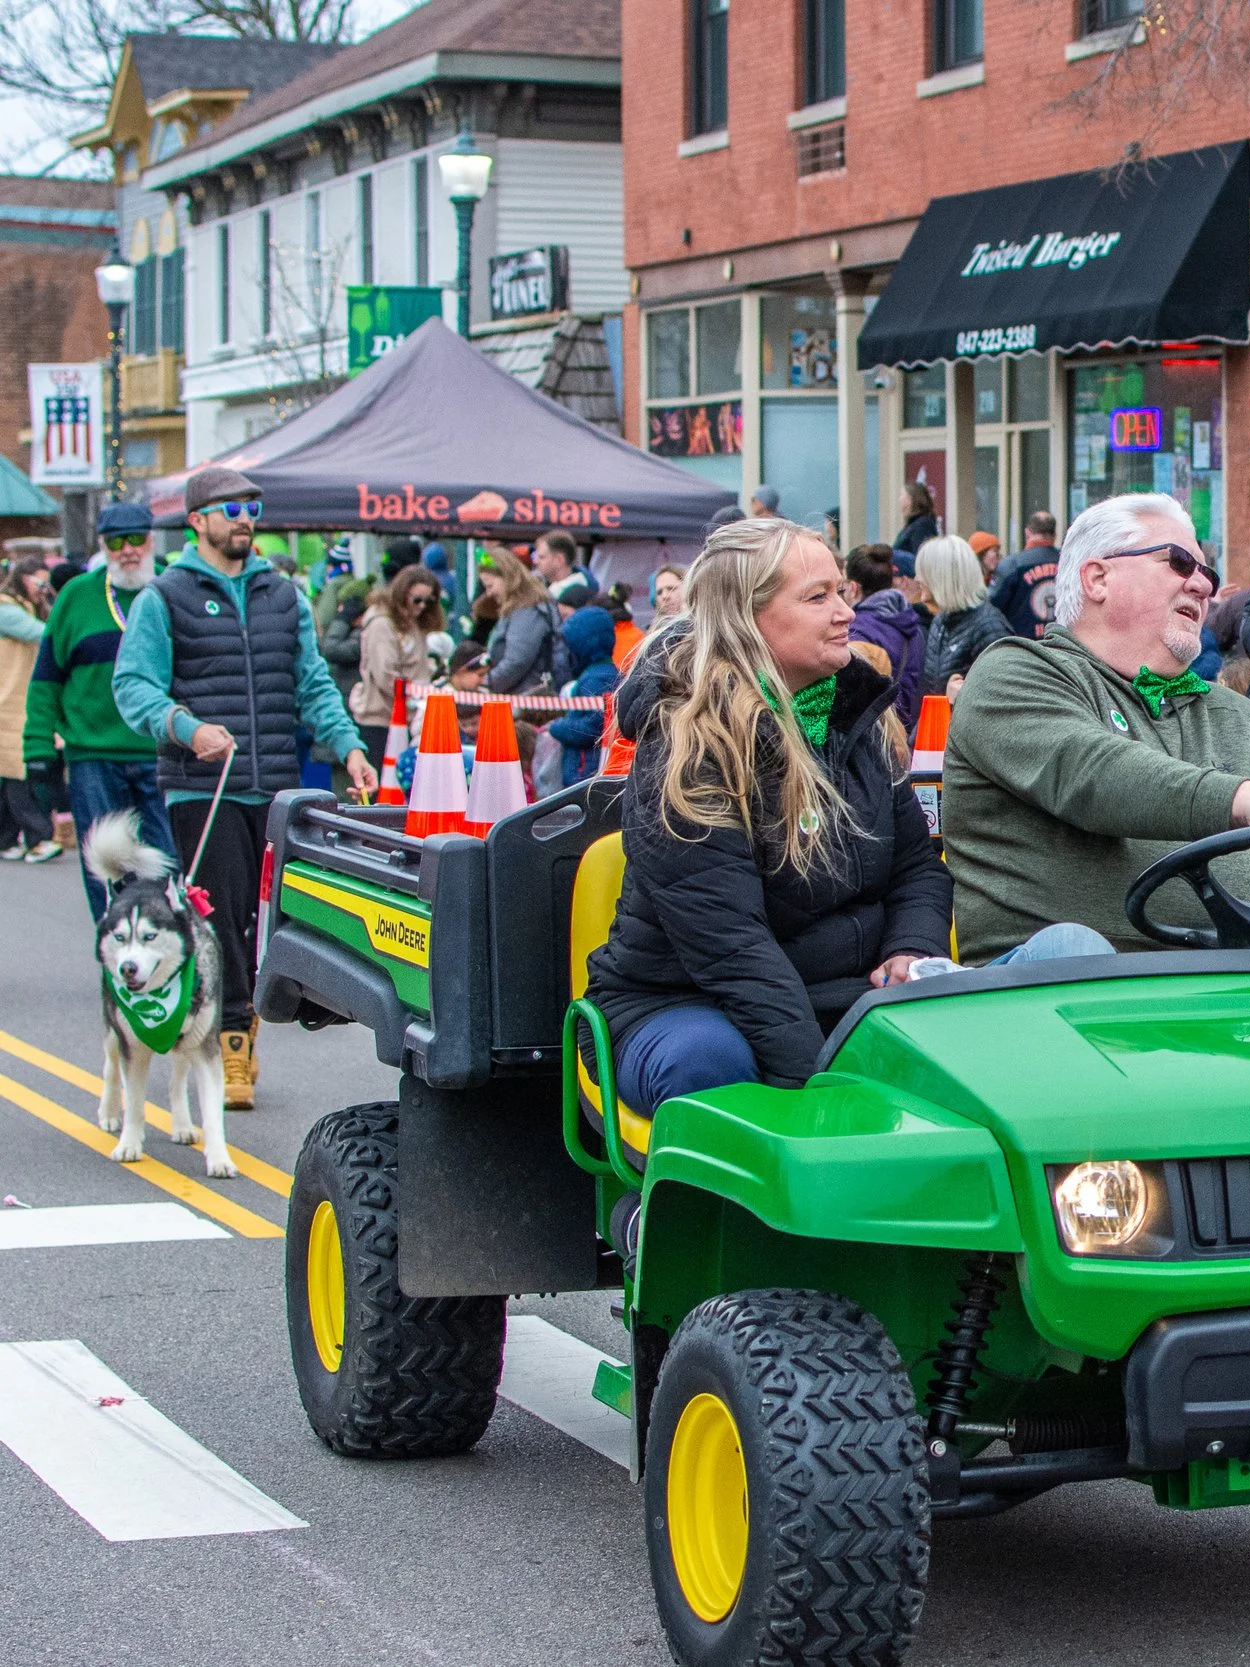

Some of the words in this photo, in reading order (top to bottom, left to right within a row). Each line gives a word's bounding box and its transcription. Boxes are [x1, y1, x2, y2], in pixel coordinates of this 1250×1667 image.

[961, 235, 1041, 277] Twisted
[1031, 231, 1121, 271] Burger
[1114, 412, 1158, 447] OPEN
[356, 483, 450, 521] bake
[513, 488, 622, 528] share
[375, 913, 397, 942] JOHN
[398, 921, 426, 953] DEERE
